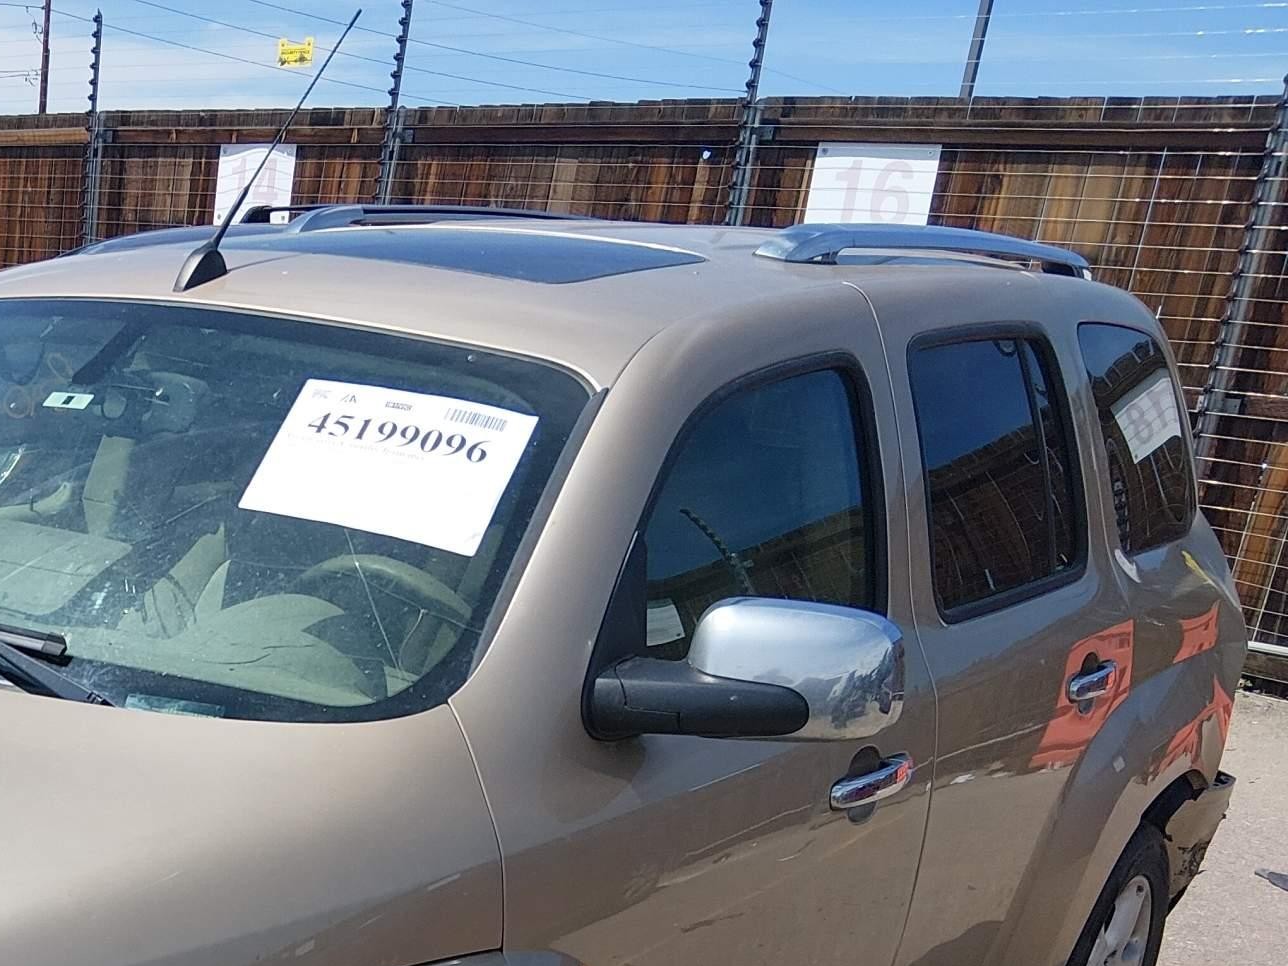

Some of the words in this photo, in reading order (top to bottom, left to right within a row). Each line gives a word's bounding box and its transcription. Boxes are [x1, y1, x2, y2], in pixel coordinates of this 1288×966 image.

[231, 158, 278, 200] 14
[835, 160, 913, 223] 16
[307, 412, 492, 463] 45199096
